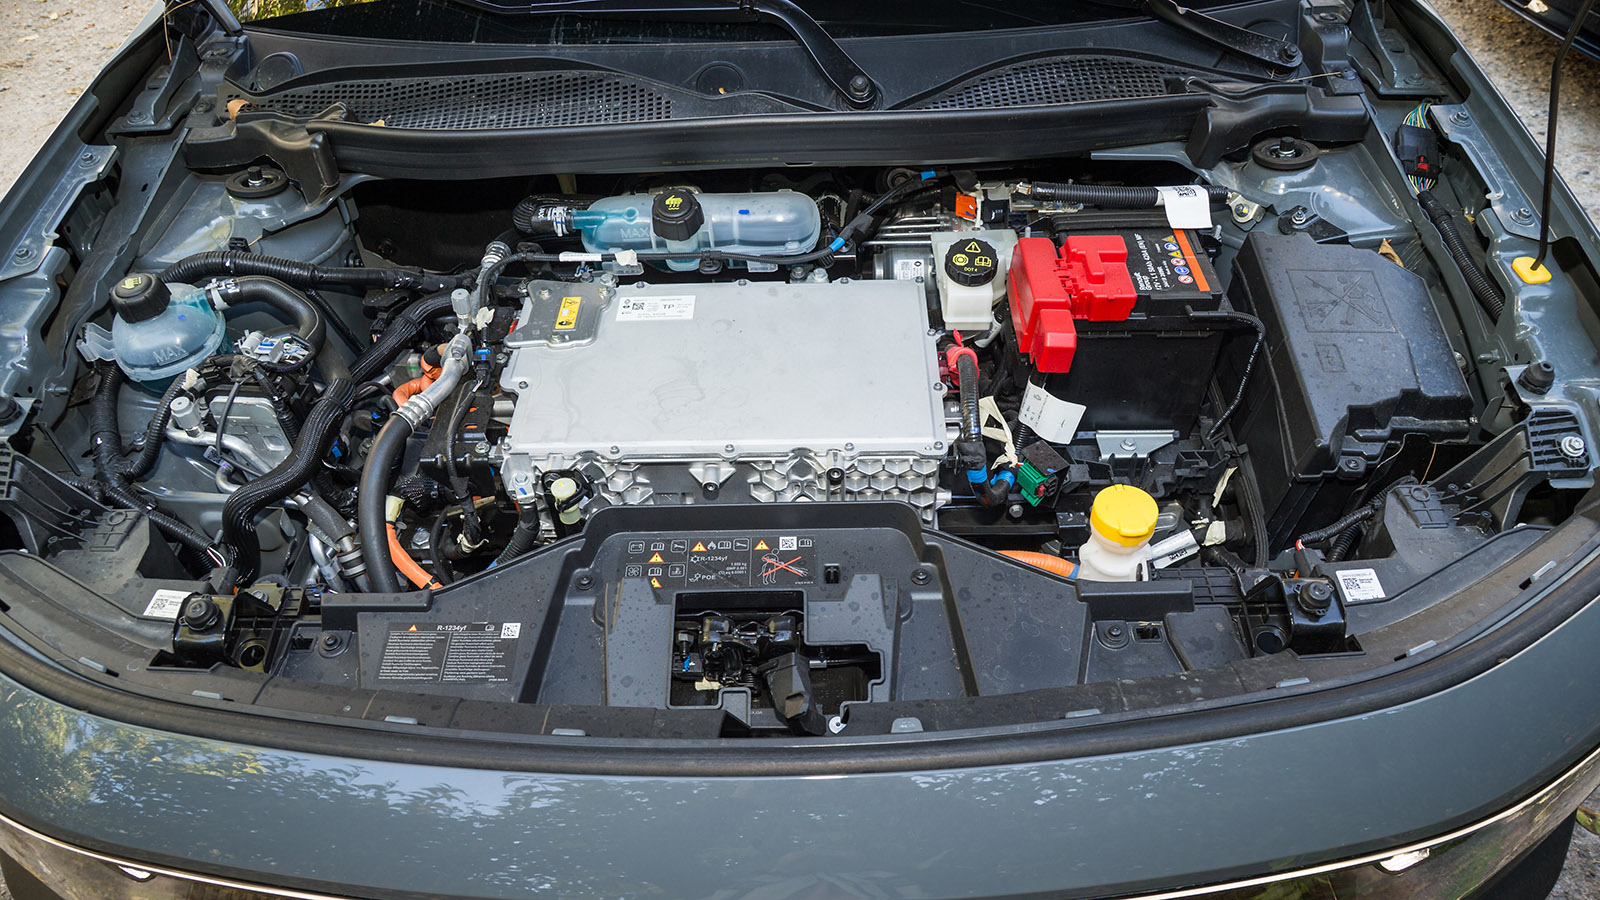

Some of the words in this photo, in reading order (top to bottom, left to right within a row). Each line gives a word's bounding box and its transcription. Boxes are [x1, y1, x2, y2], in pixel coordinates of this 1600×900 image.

[620, 226, 650, 239] MAX
[153, 344, 188, 362] MAX
[436, 624, 468, 633] R-1234yf
